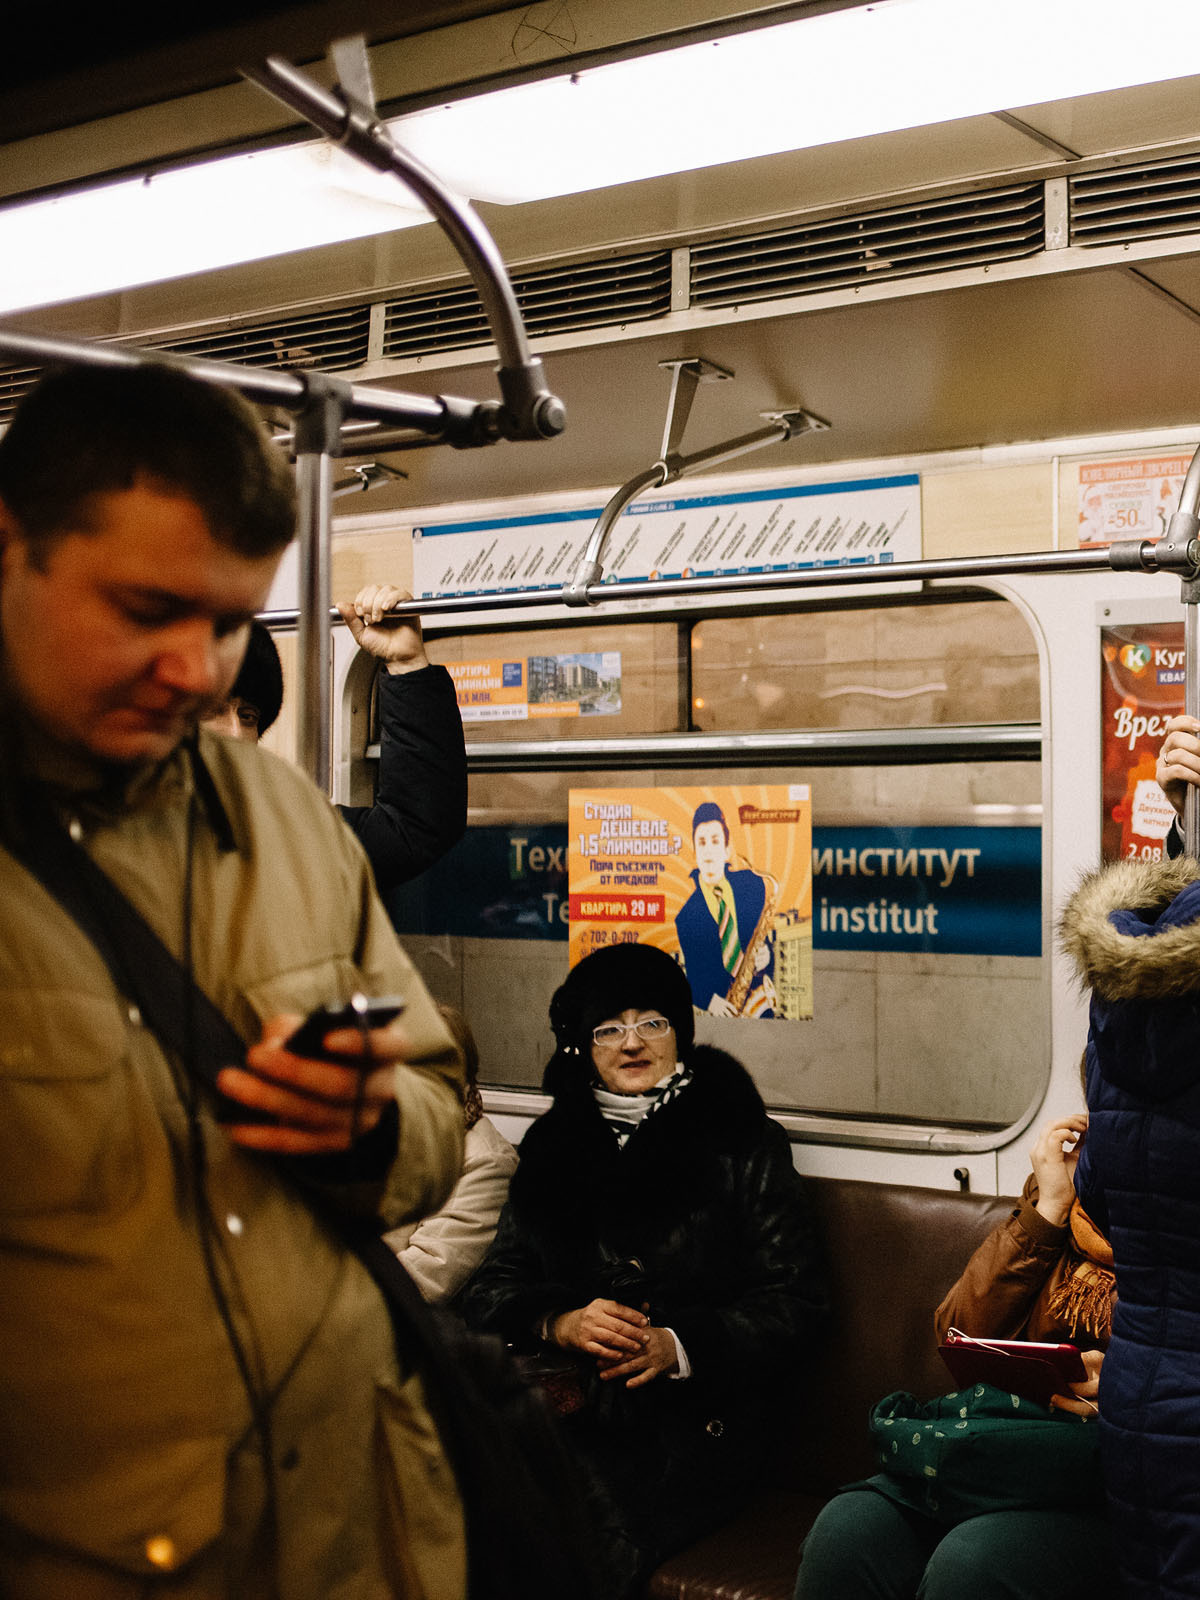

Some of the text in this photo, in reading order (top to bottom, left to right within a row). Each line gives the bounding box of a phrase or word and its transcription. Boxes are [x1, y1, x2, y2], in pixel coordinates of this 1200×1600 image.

[447, 664, 490, 677] ВАРТИРЫ
[600, 820, 668, 839] ДЕШЕВЛЕ
[579, 834, 599, 856] 1,5
[812, 847, 981, 887] институт
[580, 902, 628, 916] КВАРТИРА
[630, 899, 645, 916] 29
[820, 899, 939, 936] institut
